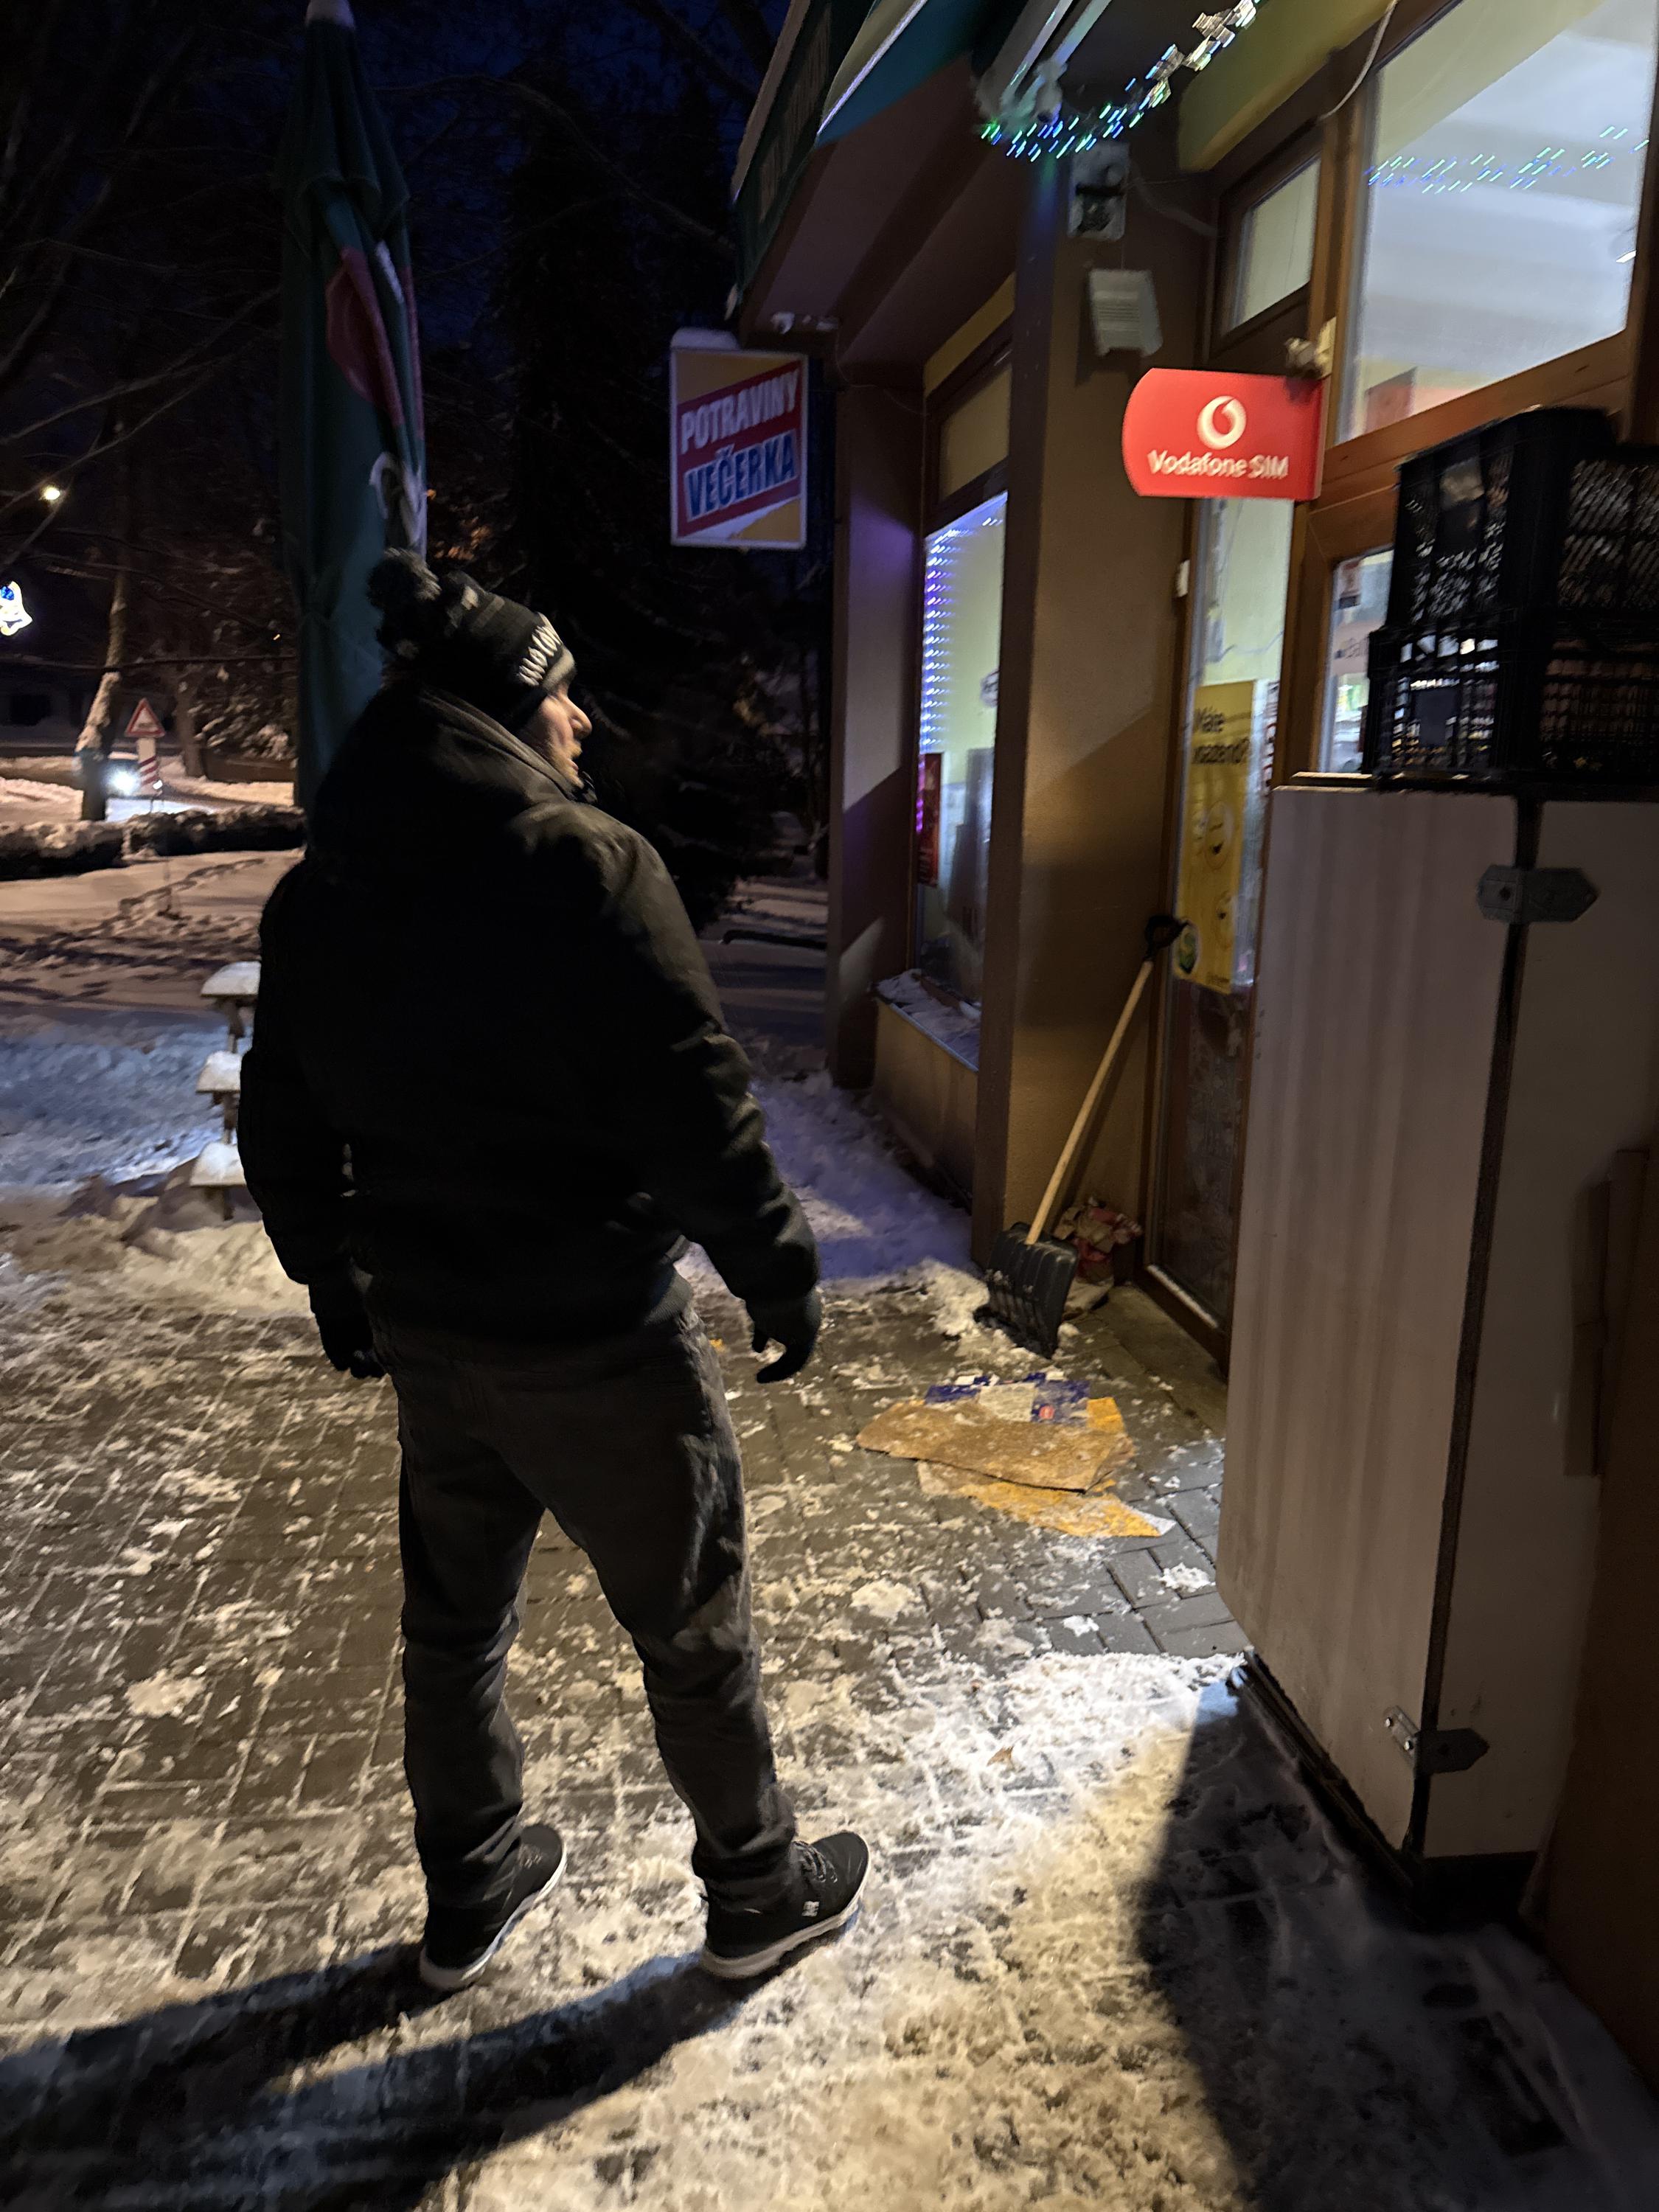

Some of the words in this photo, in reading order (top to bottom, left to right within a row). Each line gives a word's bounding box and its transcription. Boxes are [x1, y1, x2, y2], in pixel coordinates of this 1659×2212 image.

[680, 369, 799, 455] POTRAVINY
[686, 431, 796, 521] VEČERKA
[1147, 449, 1248, 479] Vodafone
[1248, 454, 1289, 479] SIM
